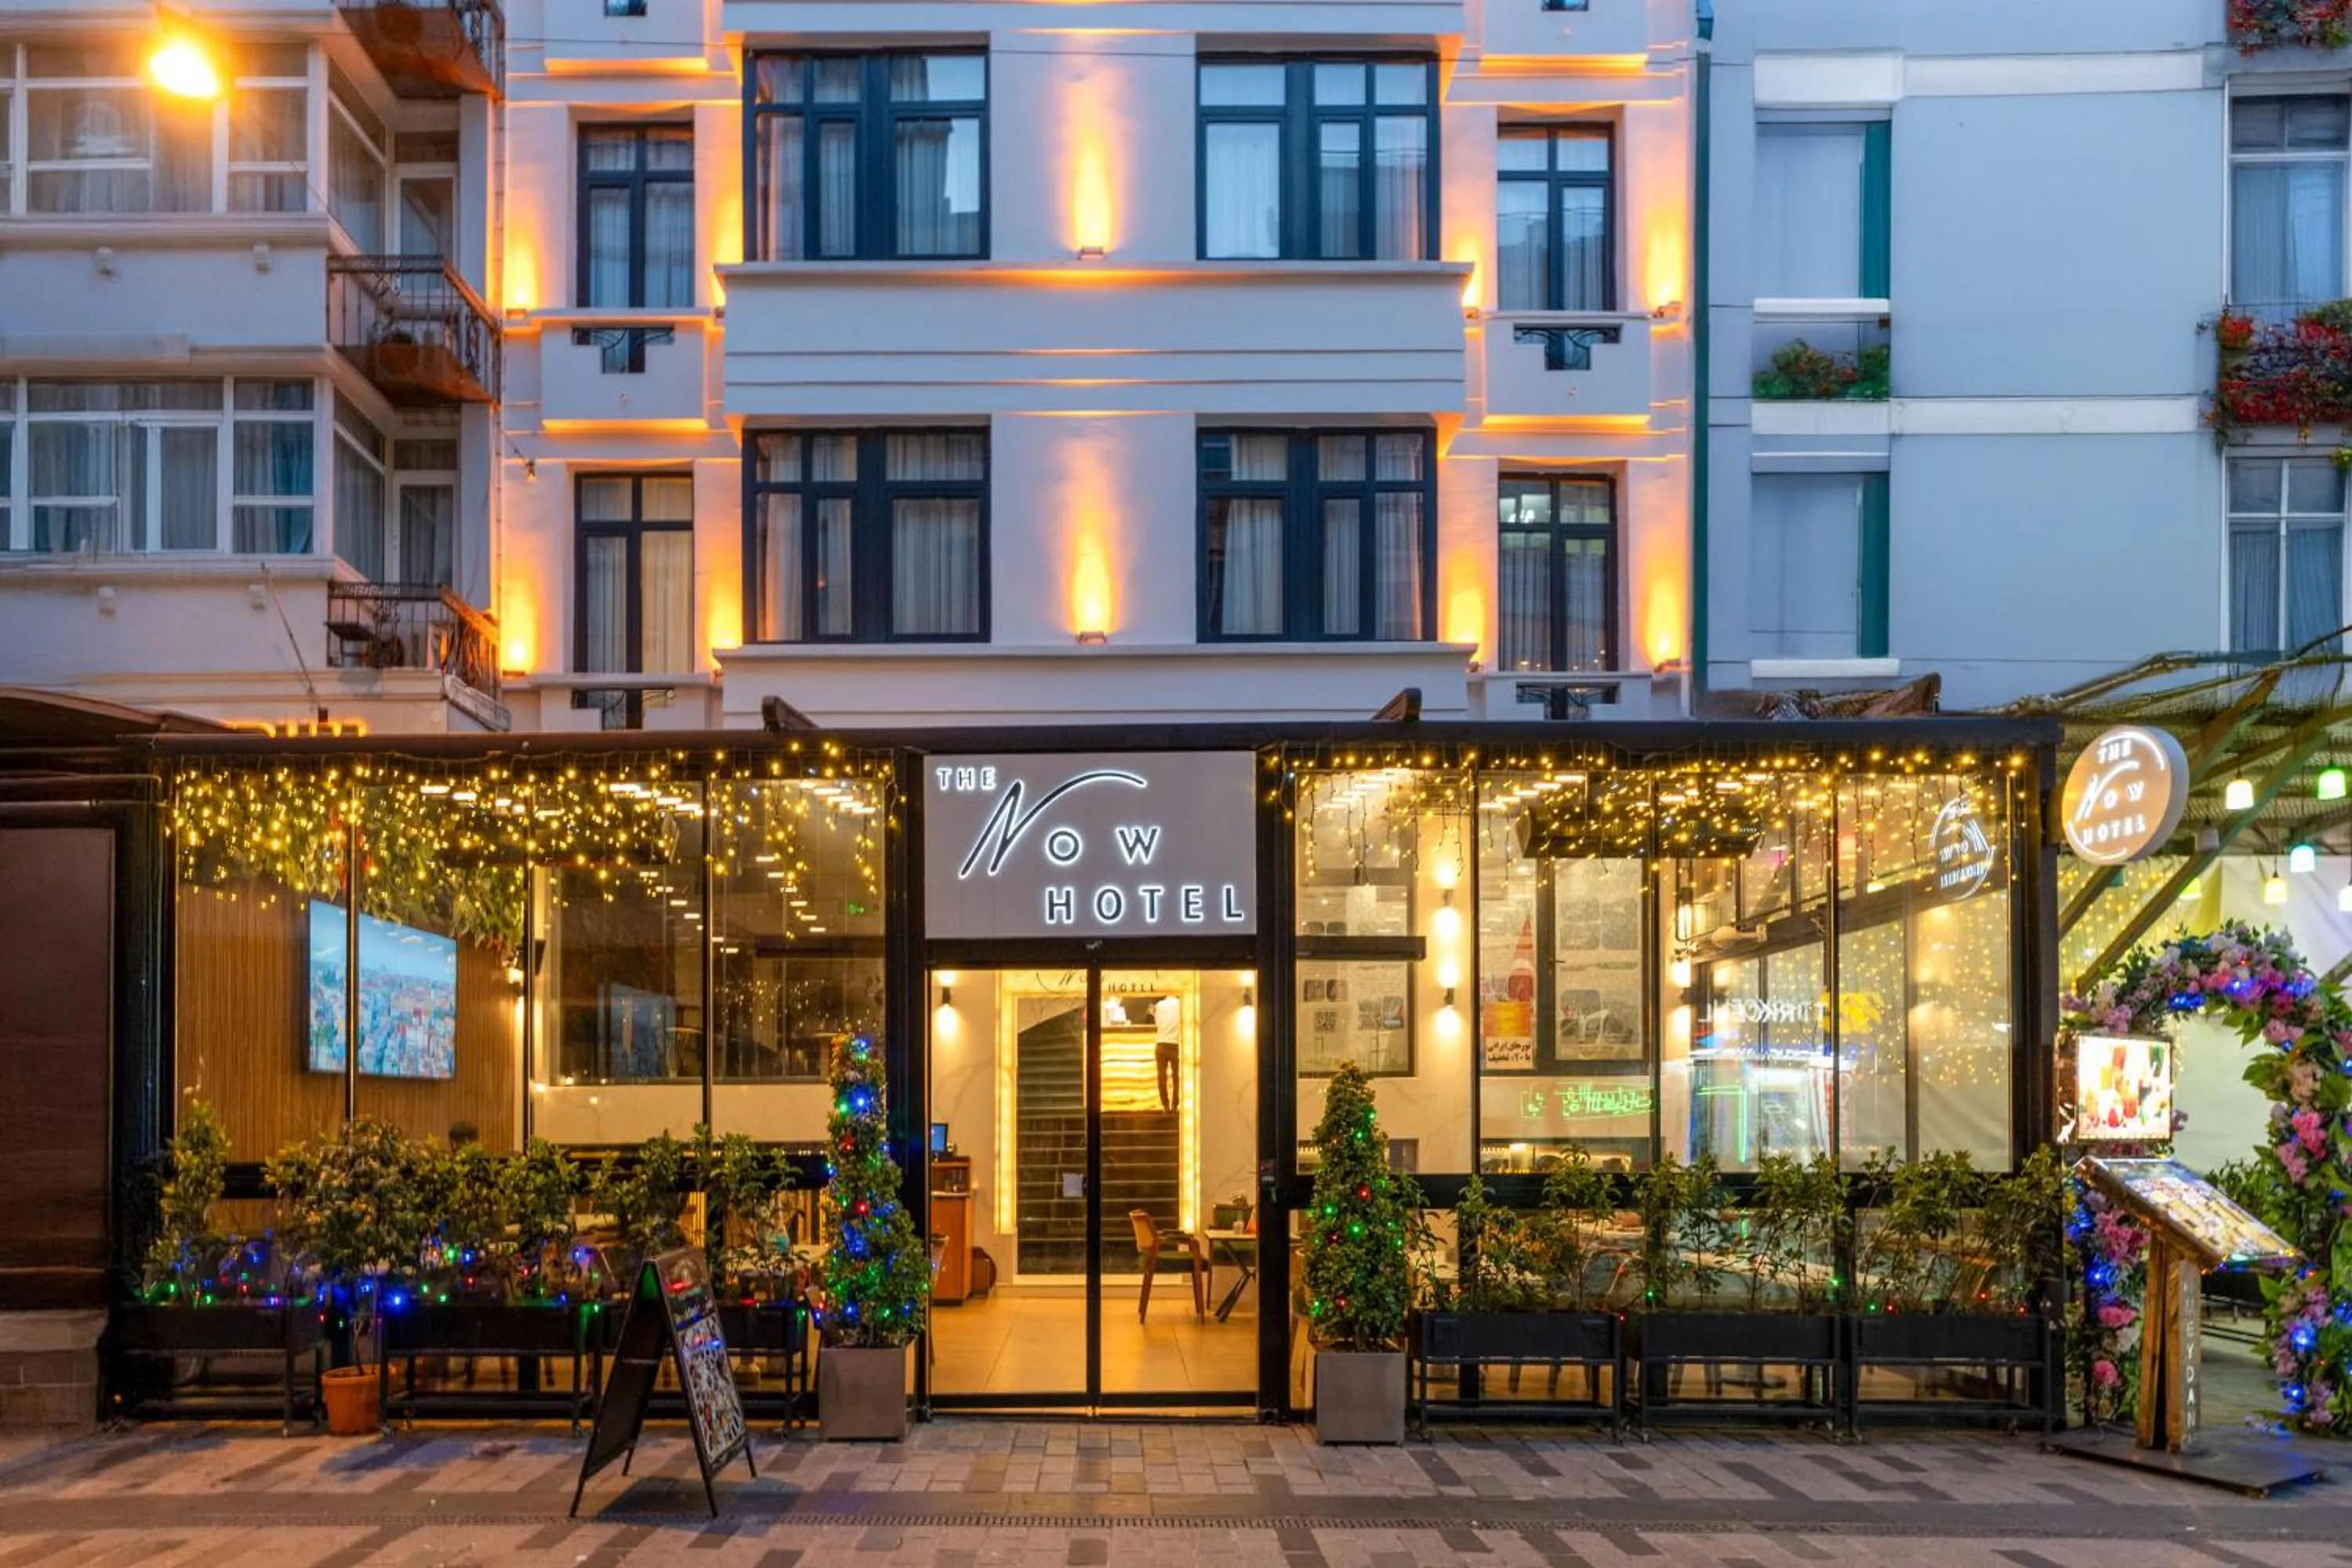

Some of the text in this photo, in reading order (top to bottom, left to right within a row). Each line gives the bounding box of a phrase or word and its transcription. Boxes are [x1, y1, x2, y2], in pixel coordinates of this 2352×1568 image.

[2096, 739, 2132, 764] THE
[938, 767, 996, 790] THE
[2082, 814, 2147, 845] HOTEL
[1045, 884, 1243, 924] HOTEL
